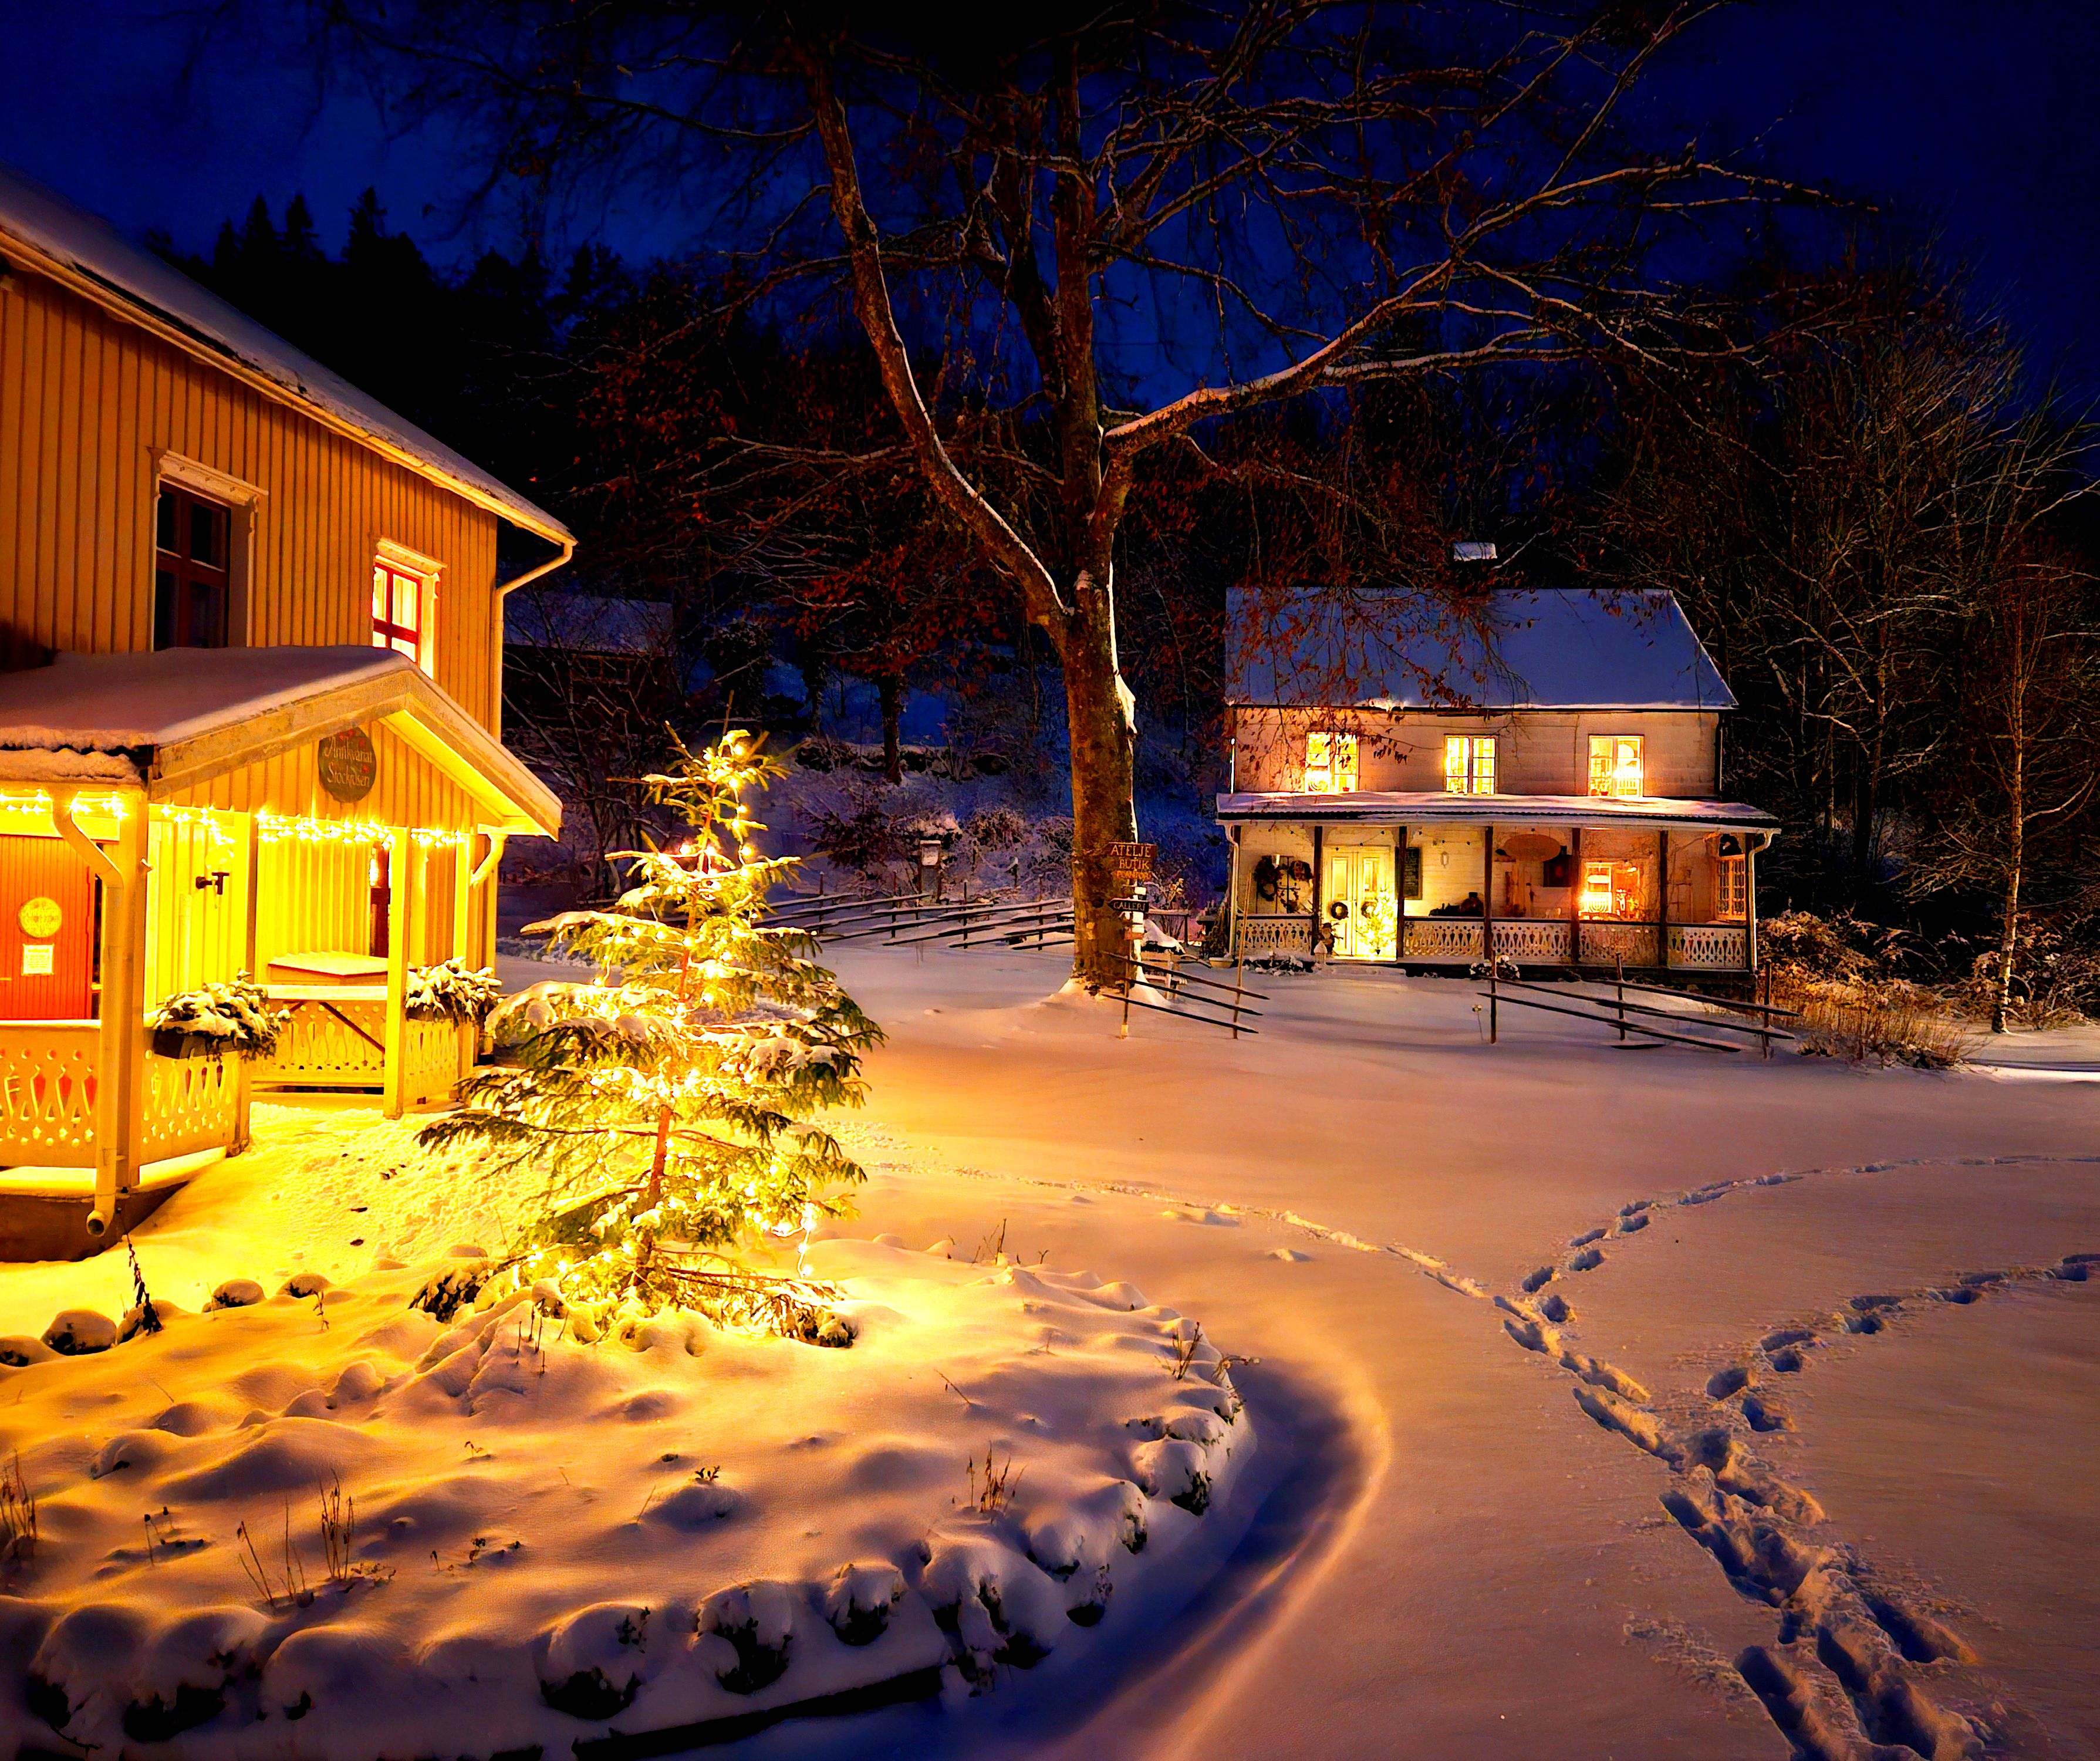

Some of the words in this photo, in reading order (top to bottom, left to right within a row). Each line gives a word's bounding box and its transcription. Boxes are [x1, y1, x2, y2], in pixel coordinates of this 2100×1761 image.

[1110, 845, 1151, 858] ATELJE
[1119, 859, 1150, 869] BUTIK
[1113, 901, 1146, 912] GALLERI
